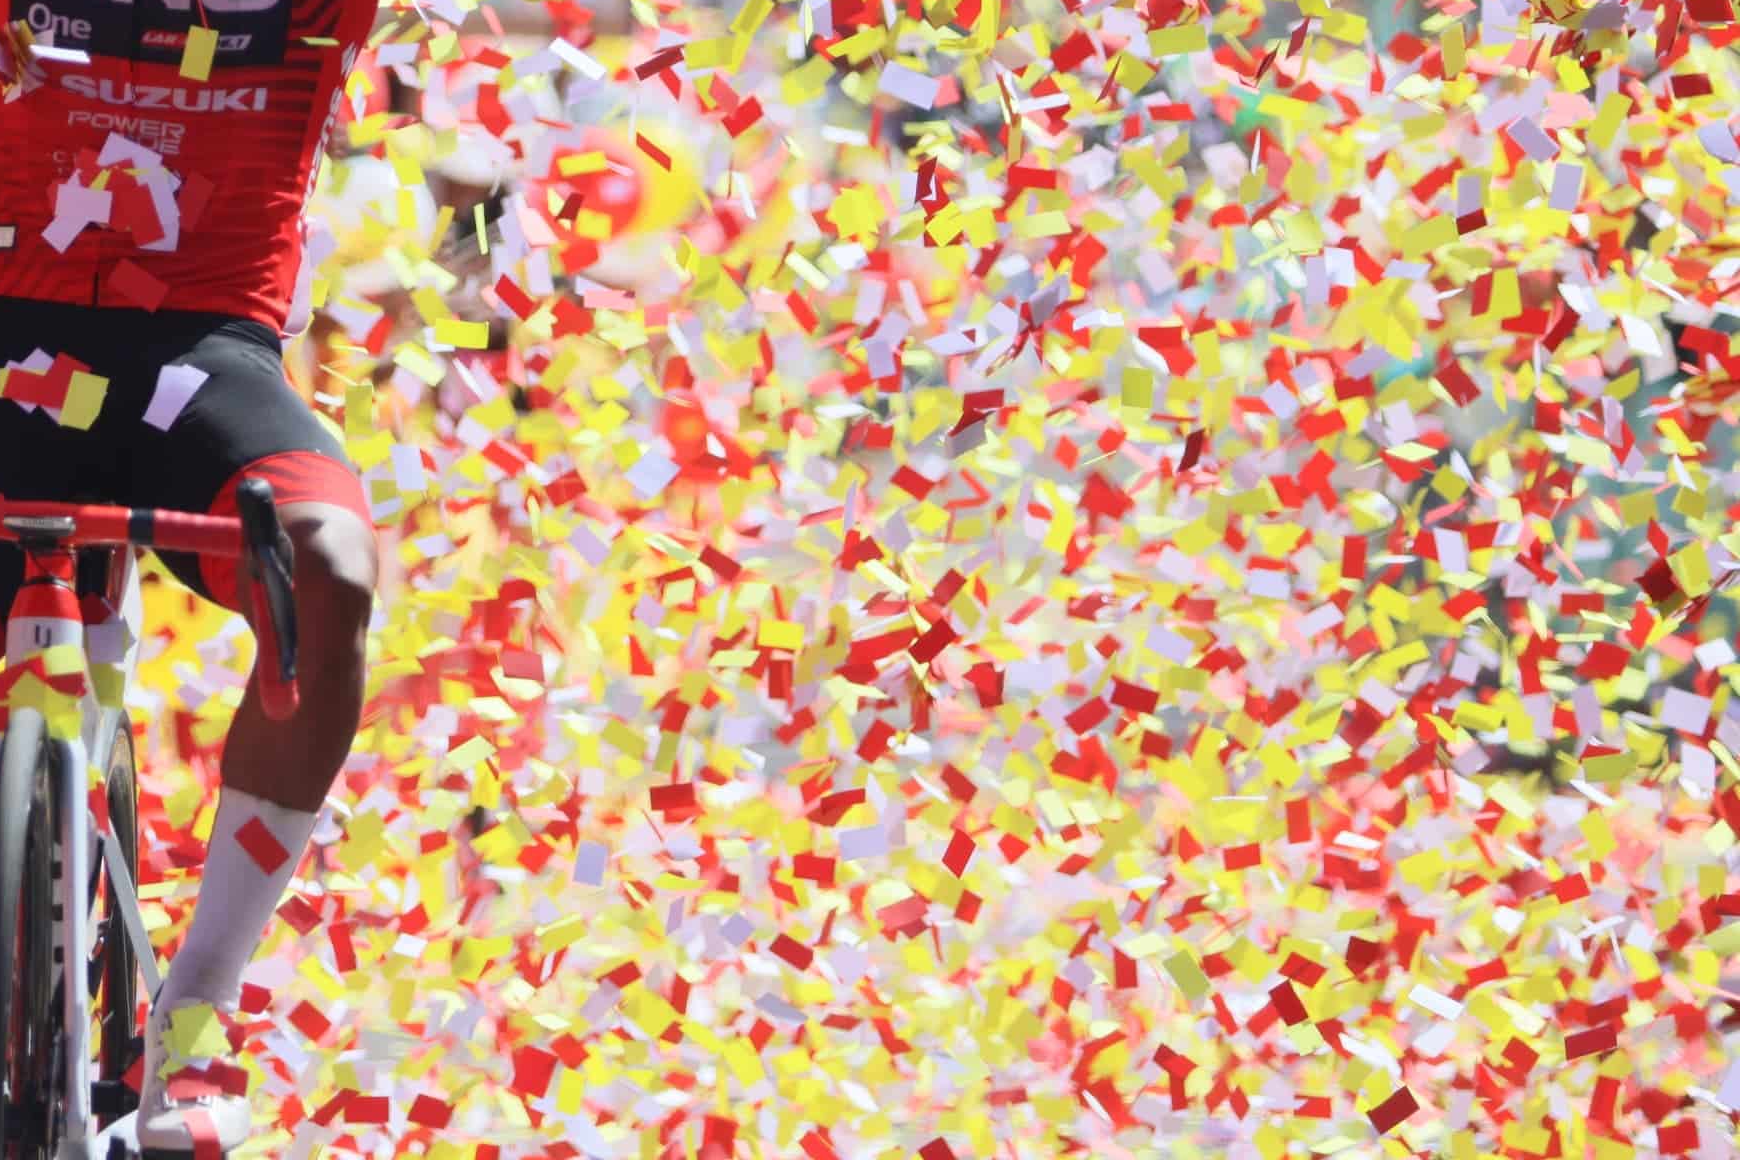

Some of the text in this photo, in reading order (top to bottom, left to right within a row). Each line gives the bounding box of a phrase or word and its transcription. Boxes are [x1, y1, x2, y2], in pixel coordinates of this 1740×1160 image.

[27, 2, 93, 40] One
[61, 74, 269, 113] SUZUKI
[67, 110, 187, 140] POWER
